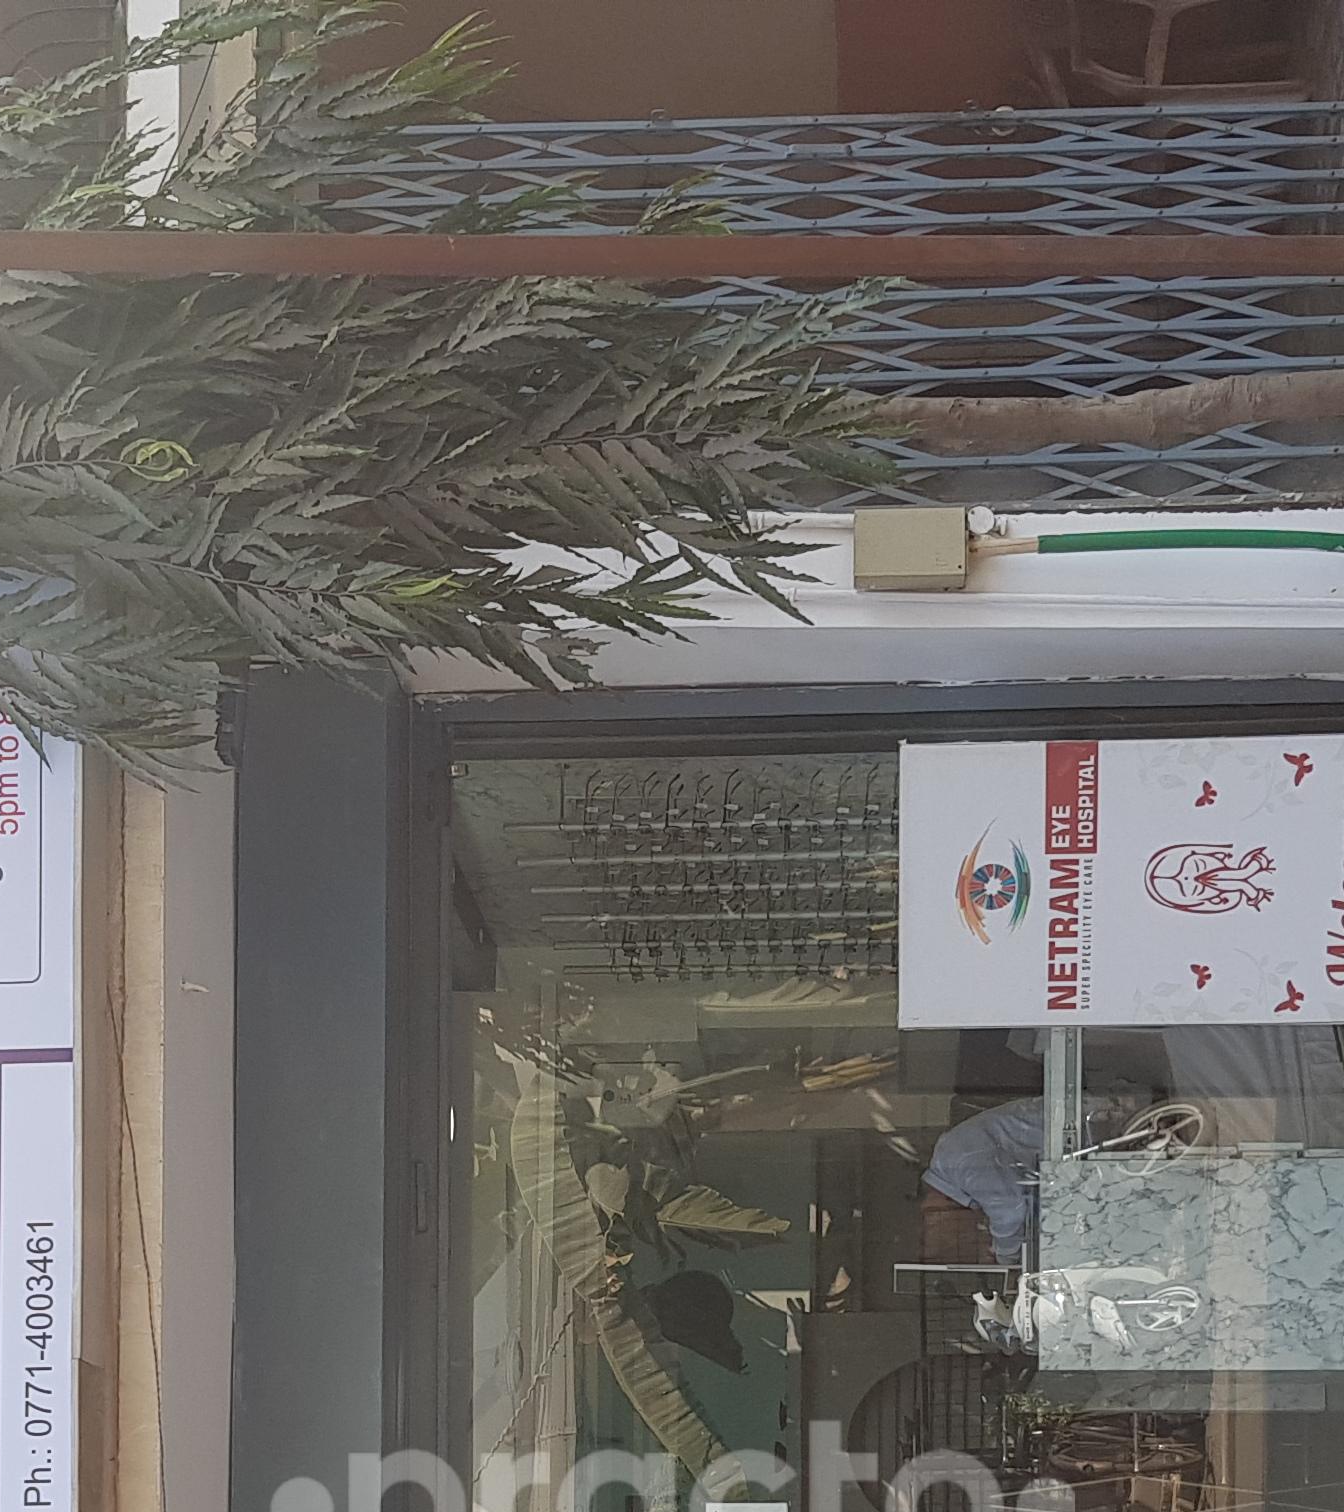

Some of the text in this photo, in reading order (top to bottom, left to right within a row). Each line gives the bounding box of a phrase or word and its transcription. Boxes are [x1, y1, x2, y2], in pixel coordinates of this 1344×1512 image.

[1051, 805, 1071, 848] EYE
[1078, 755, 1095, 848] HOSPITAL
[1083, 857, 1093, 885] CARE
[1082, 891, 1093, 910] EYE
[1047, 858, 1080, 1010] NETRAM
[1080, 976, 1090, 1010] SUPER
[23, 1220, 54, 1438] 0771-4003461
[23, 1447, 53, 1507] Ph.:
